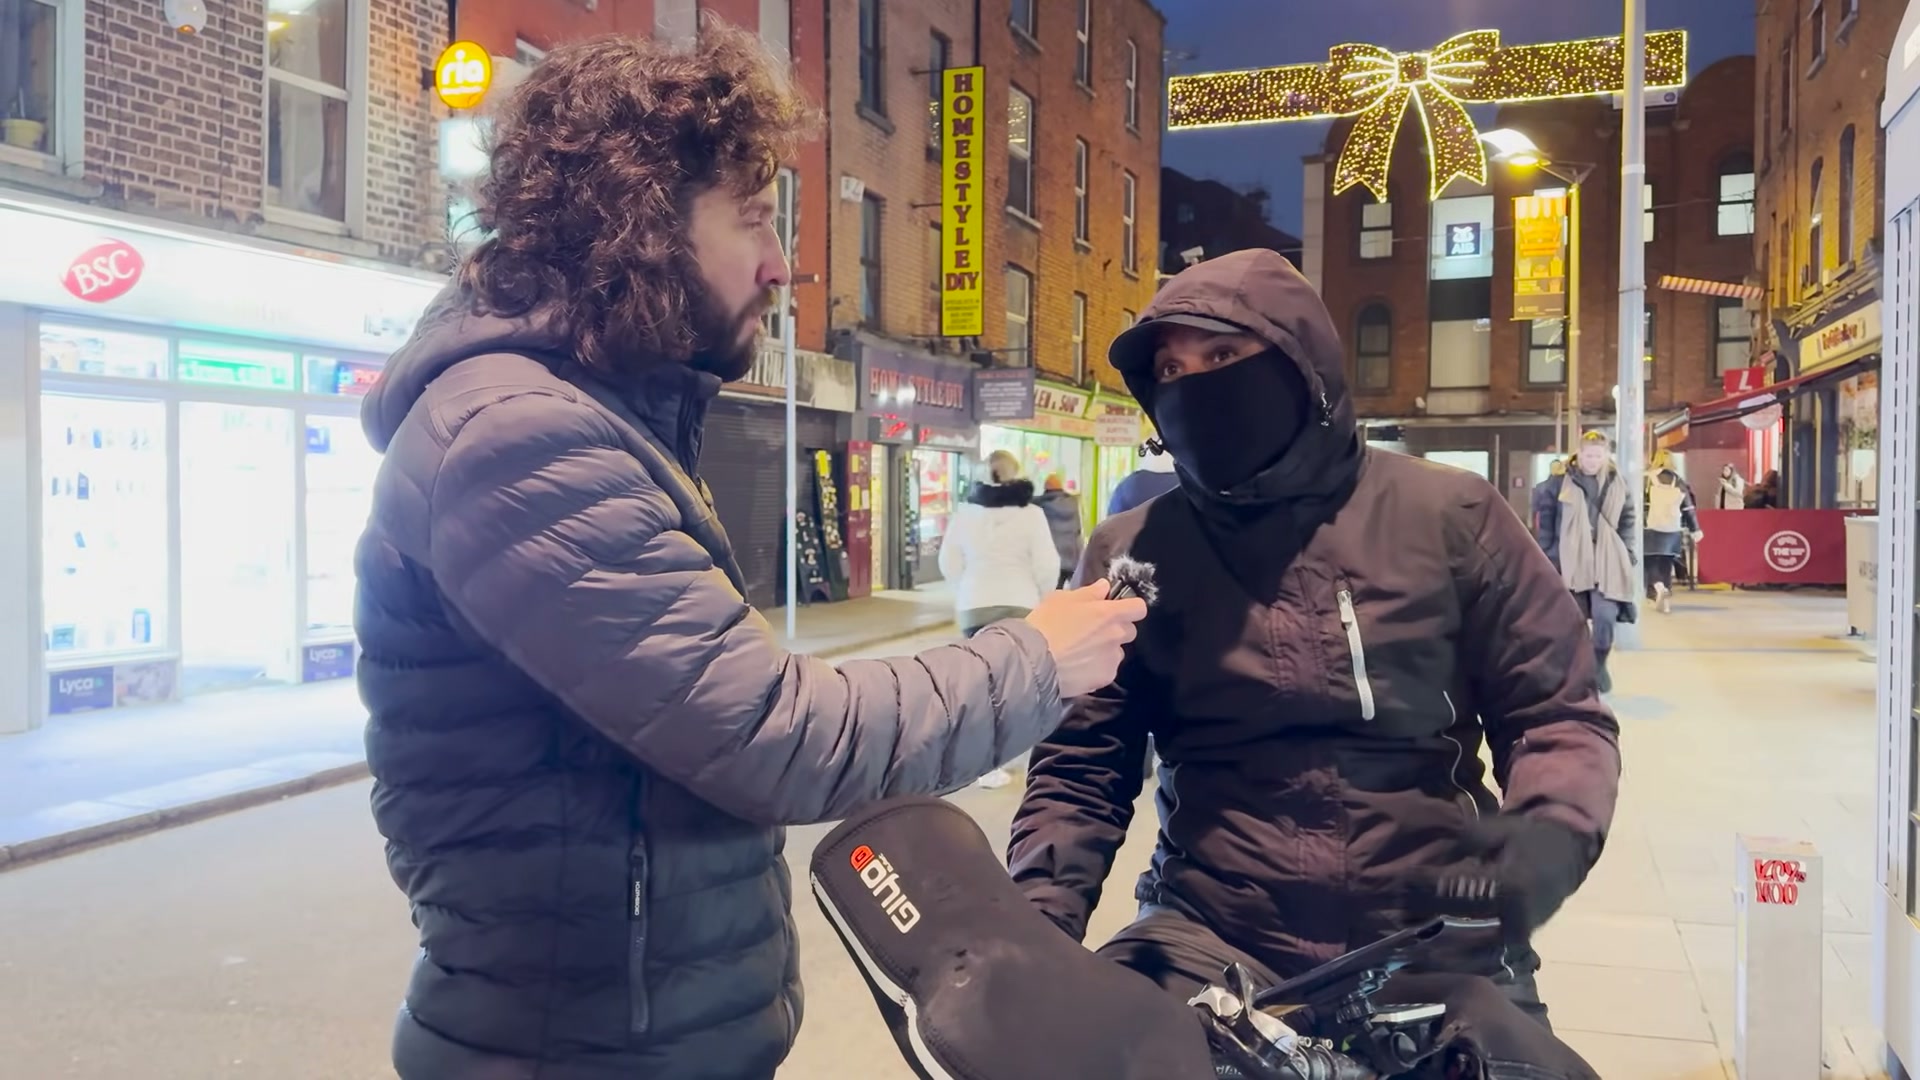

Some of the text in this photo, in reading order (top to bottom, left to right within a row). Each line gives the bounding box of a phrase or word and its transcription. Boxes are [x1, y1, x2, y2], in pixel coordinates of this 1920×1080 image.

[441, 49, 485, 86] ria
[952, 73, 974, 269] HOMESTYLE
[1451, 241, 1476, 255] AIB
[71, 249, 136, 297] BSC
[945, 271, 980, 292] DIY
[59, 677, 95, 695] Lyca
